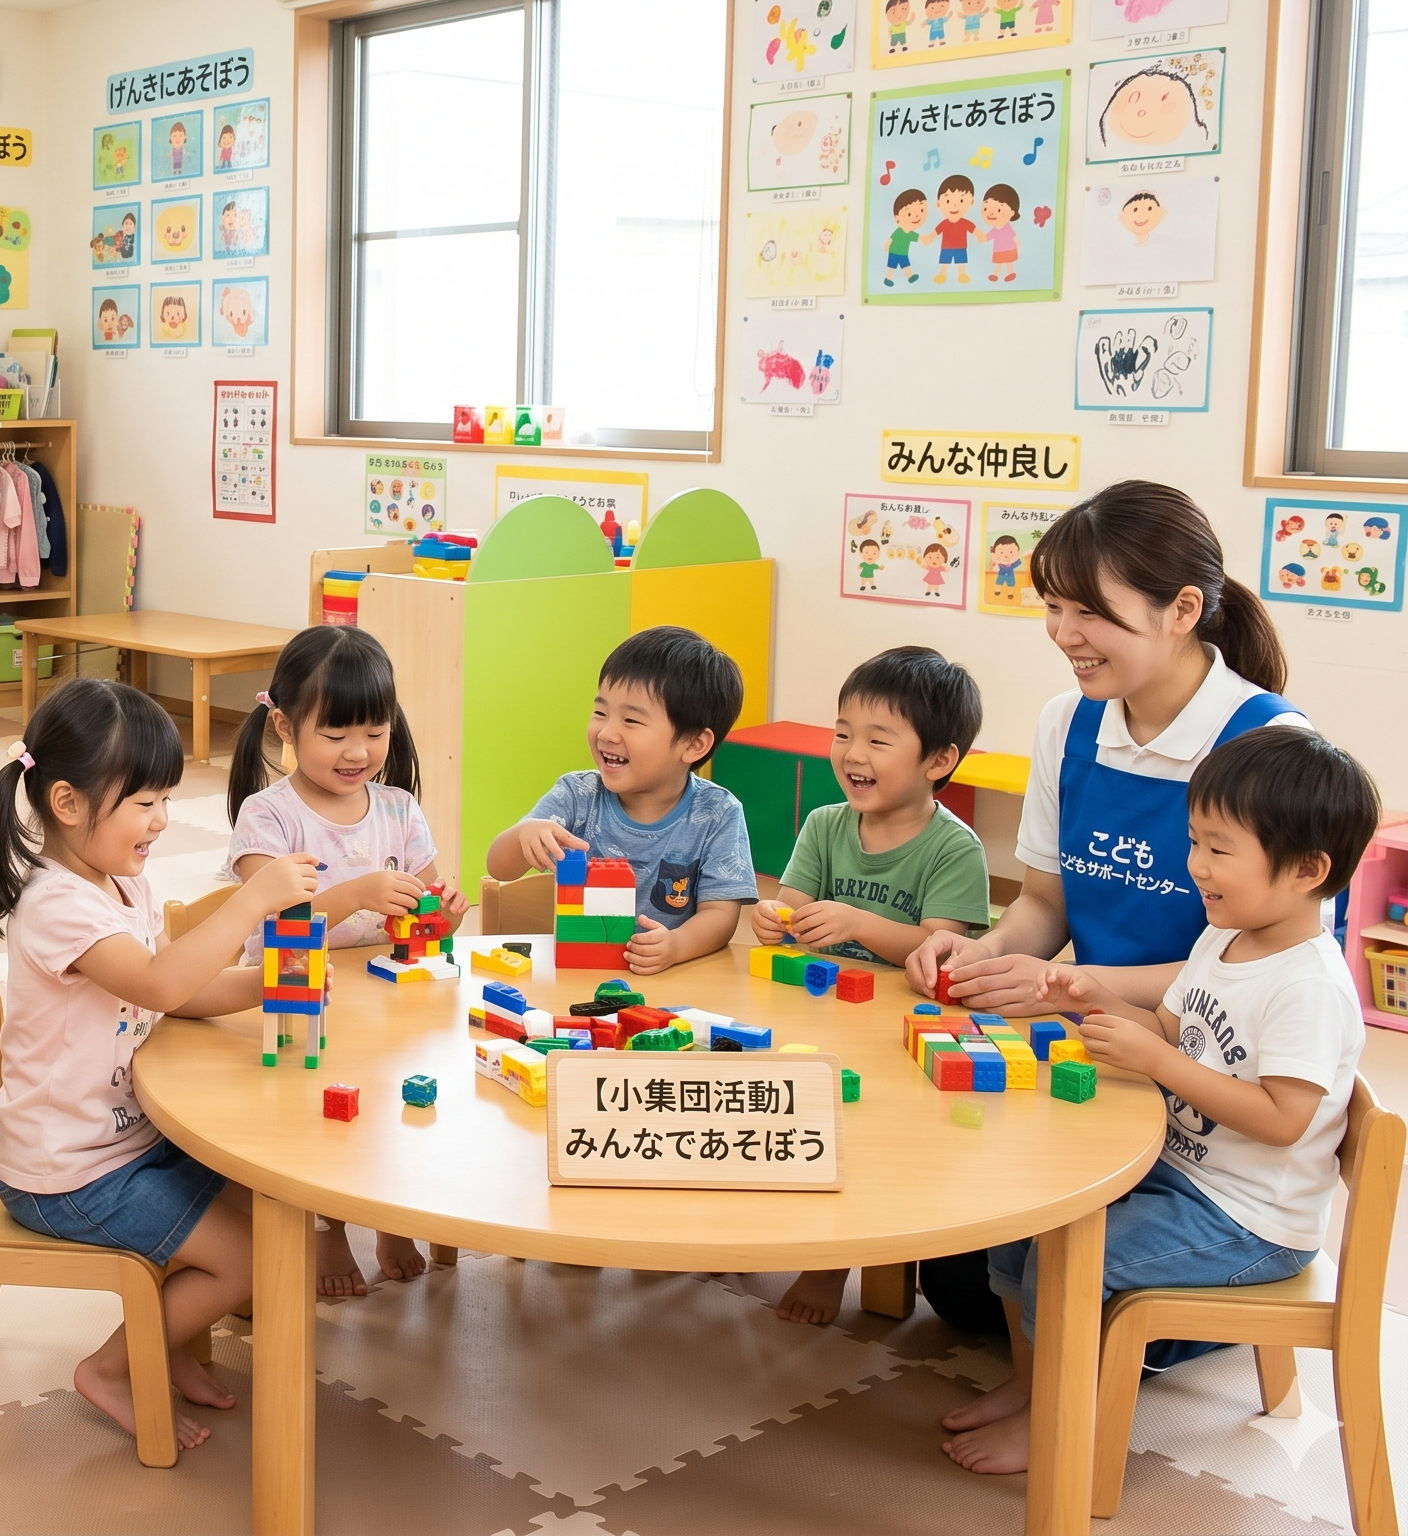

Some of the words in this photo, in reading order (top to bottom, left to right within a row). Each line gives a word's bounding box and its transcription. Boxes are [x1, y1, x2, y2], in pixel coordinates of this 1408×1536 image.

[109, 56, 250, 109] げんきにあそぼう
[879, 92, 1055, 138] げんきにあそぼう
[887, 441, 1068, 479] みんな仲良し
[1088, 830, 1154, 869] こども
[596, 1077, 795, 1115] 【小集団活動】
[565, 1127, 825, 1162] みんなであそぼう
